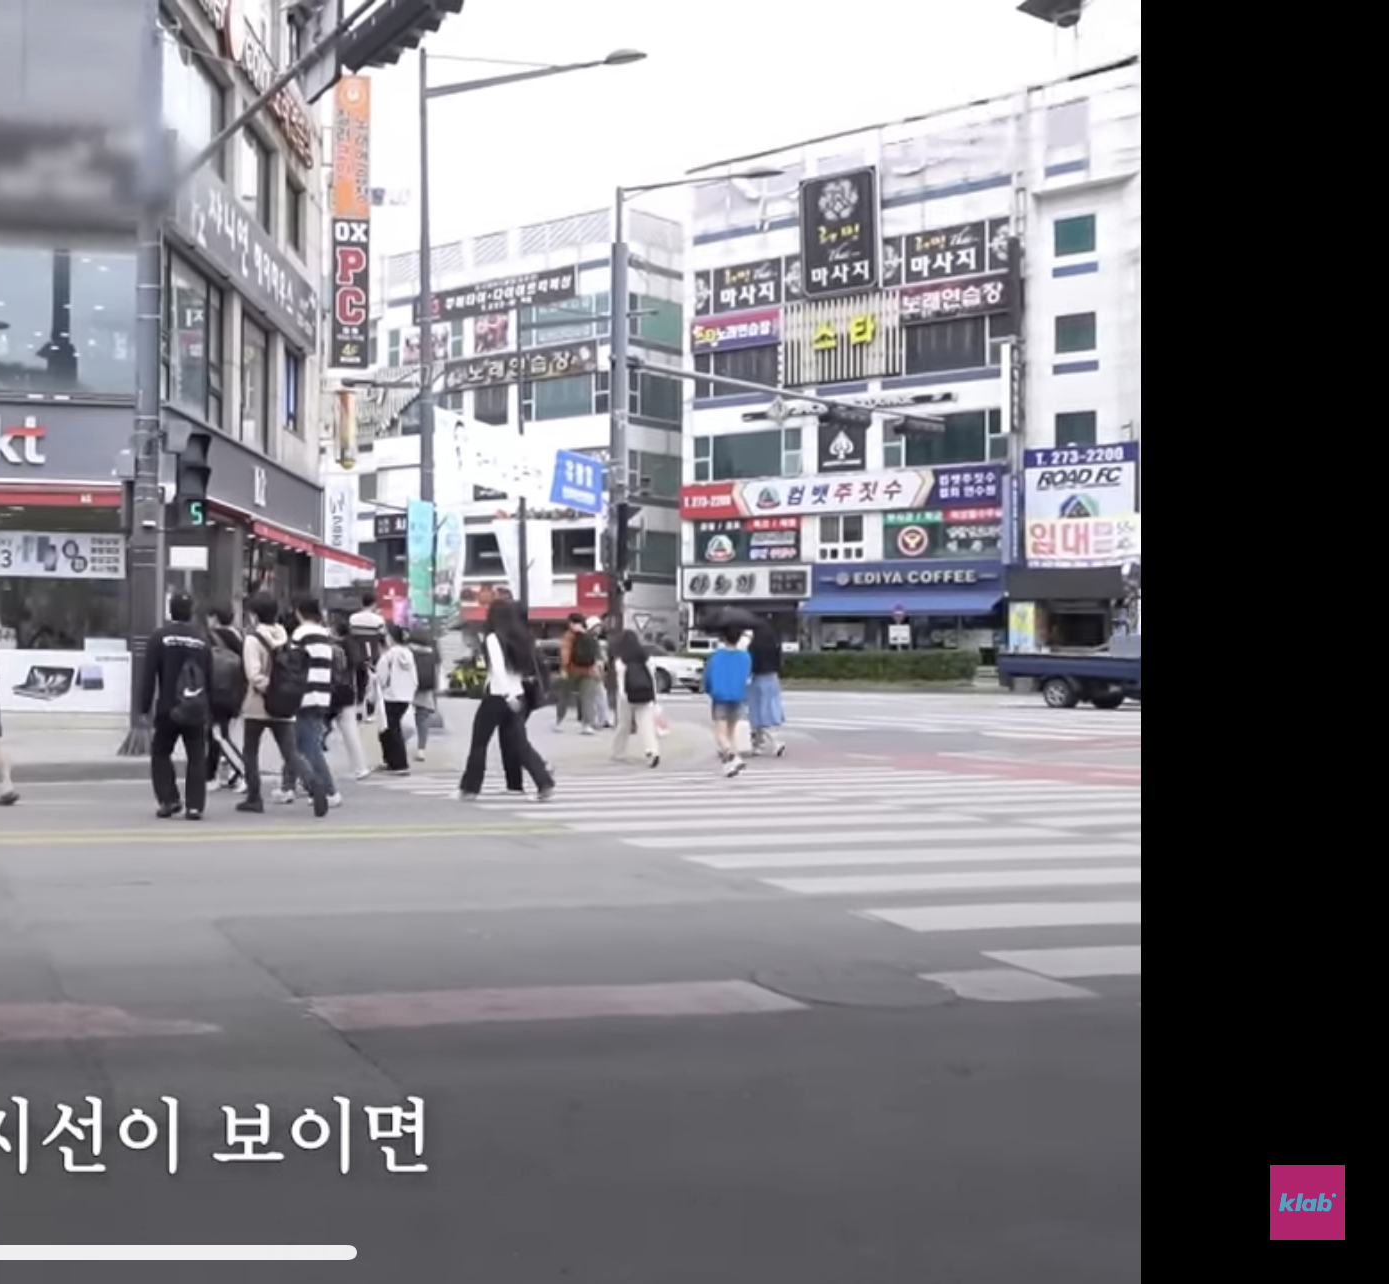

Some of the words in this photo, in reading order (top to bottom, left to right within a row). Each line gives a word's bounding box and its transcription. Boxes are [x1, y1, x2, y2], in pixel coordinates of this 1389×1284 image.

[334, 221, 368, 242] OX
[811, 258, 870, 288] 마사지
[910, 247, 977, 277] 마사지
[335, 246, 367, 326] PC
[720, 280, 776, 308] 마사지
[901, 281, 1004, 315] 노래연습장
[812, 314, 876, 349] 스타
[1037, 468, 1092, 487] ROAD
[1096, 466, 1122, 483] FC
[190, 501, 203, 525] 5
[1030, 522, 1089, 555] 임대
[853, 571, 903, 585] EDIYA
[907, 569, 977, 584] COFFEE
